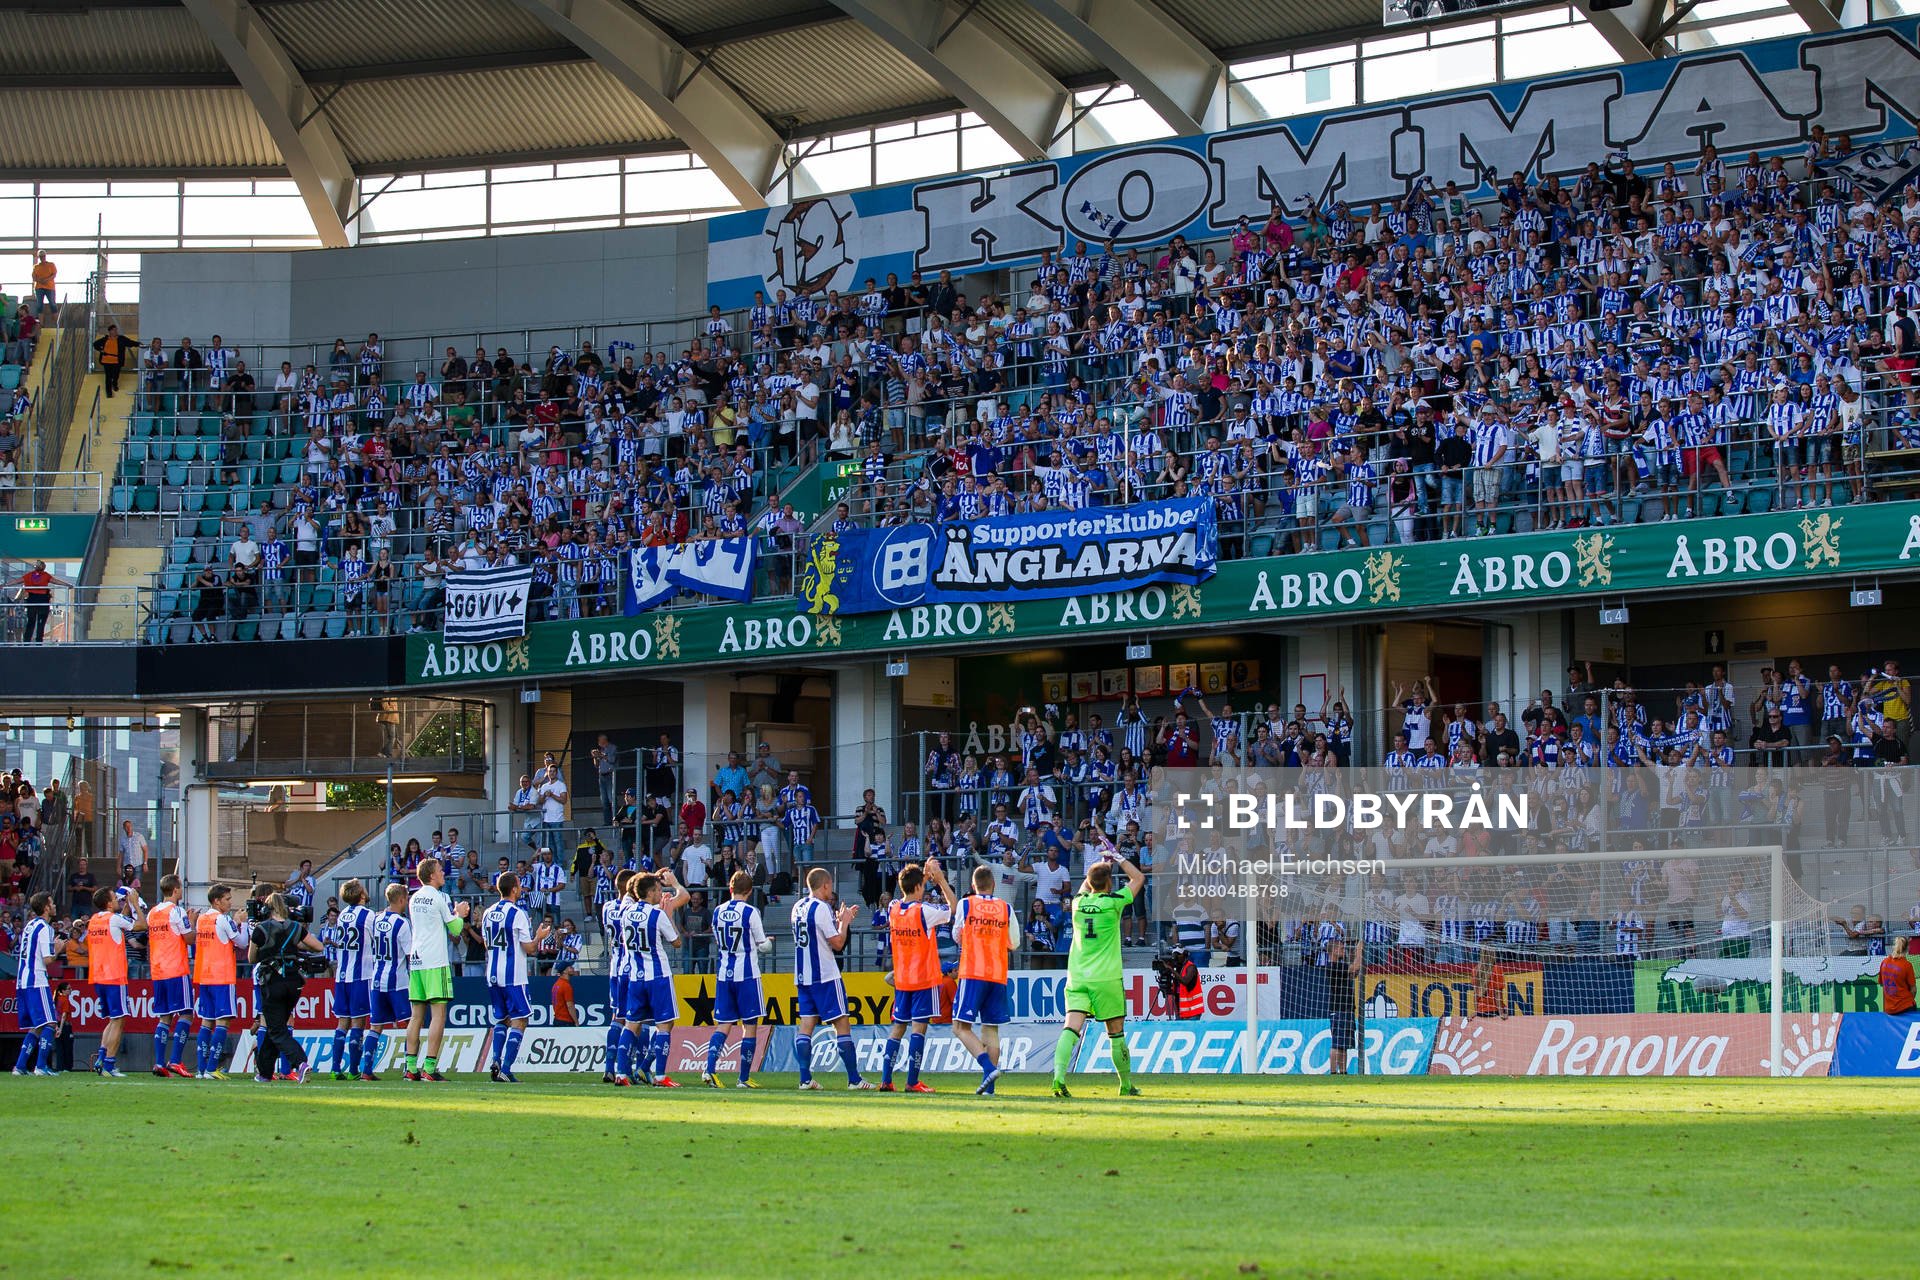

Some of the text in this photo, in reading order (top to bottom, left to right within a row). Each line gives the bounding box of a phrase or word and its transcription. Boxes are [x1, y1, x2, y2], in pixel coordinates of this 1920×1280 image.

[773, 200, 847, 294] 12
[936, 528, 1198, 584] ÄNGLARNA
[1449, 551, 1571, 596] ÅBRO
[1666, 531, 1797, 580] ÅBRO
[1248, 568, 1364, 612] ÅBRO
[1856, 592, 1865, 605] G
[718, 615, 811, 653] ÅBRO
[1604, 611, 1623, 623] G 4
[421, 642, 503, 678] ÅBRO
[565, 629, 651, 666] ÅBRO
[336, 926, 359, 950] 22
[486, 926, 508, 952] 14
[626, 925, 650, 952] 21
[718, 926, 742, 952] 17
[1084, 918, 1097, 939] 1
[374, 936, 392, 960] 11
[1409, 982, 1534, 1018] JOTN
[1526, 1019, 1730, 1076] Renova
